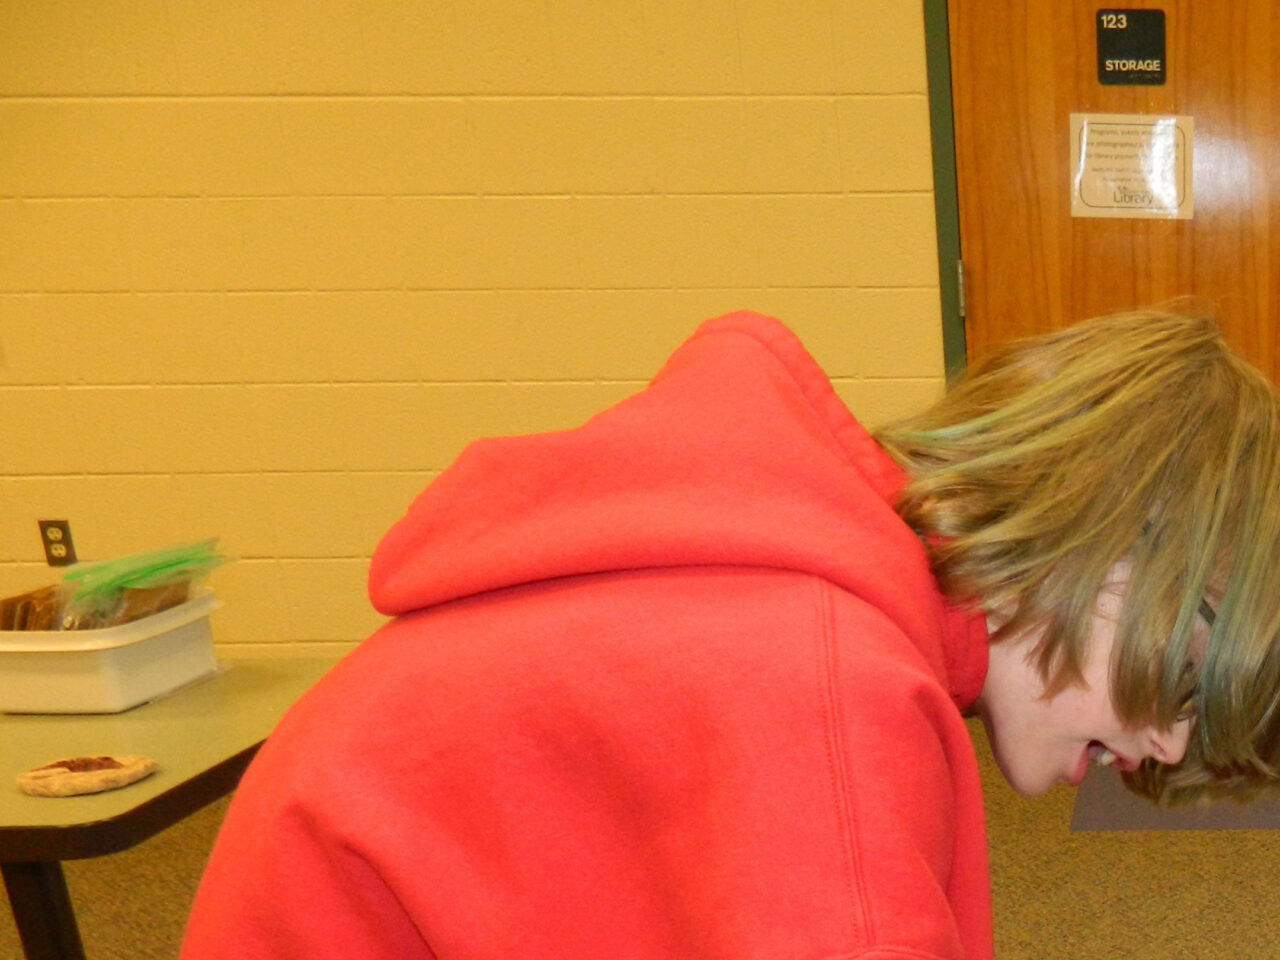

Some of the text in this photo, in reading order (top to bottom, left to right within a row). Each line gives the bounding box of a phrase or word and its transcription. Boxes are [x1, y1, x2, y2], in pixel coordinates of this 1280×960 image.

[1101, 14, 1127, 29] 123
[1105, 60, 1161, 71] STORAGE
[1113, 191, 1154, 205] Library
